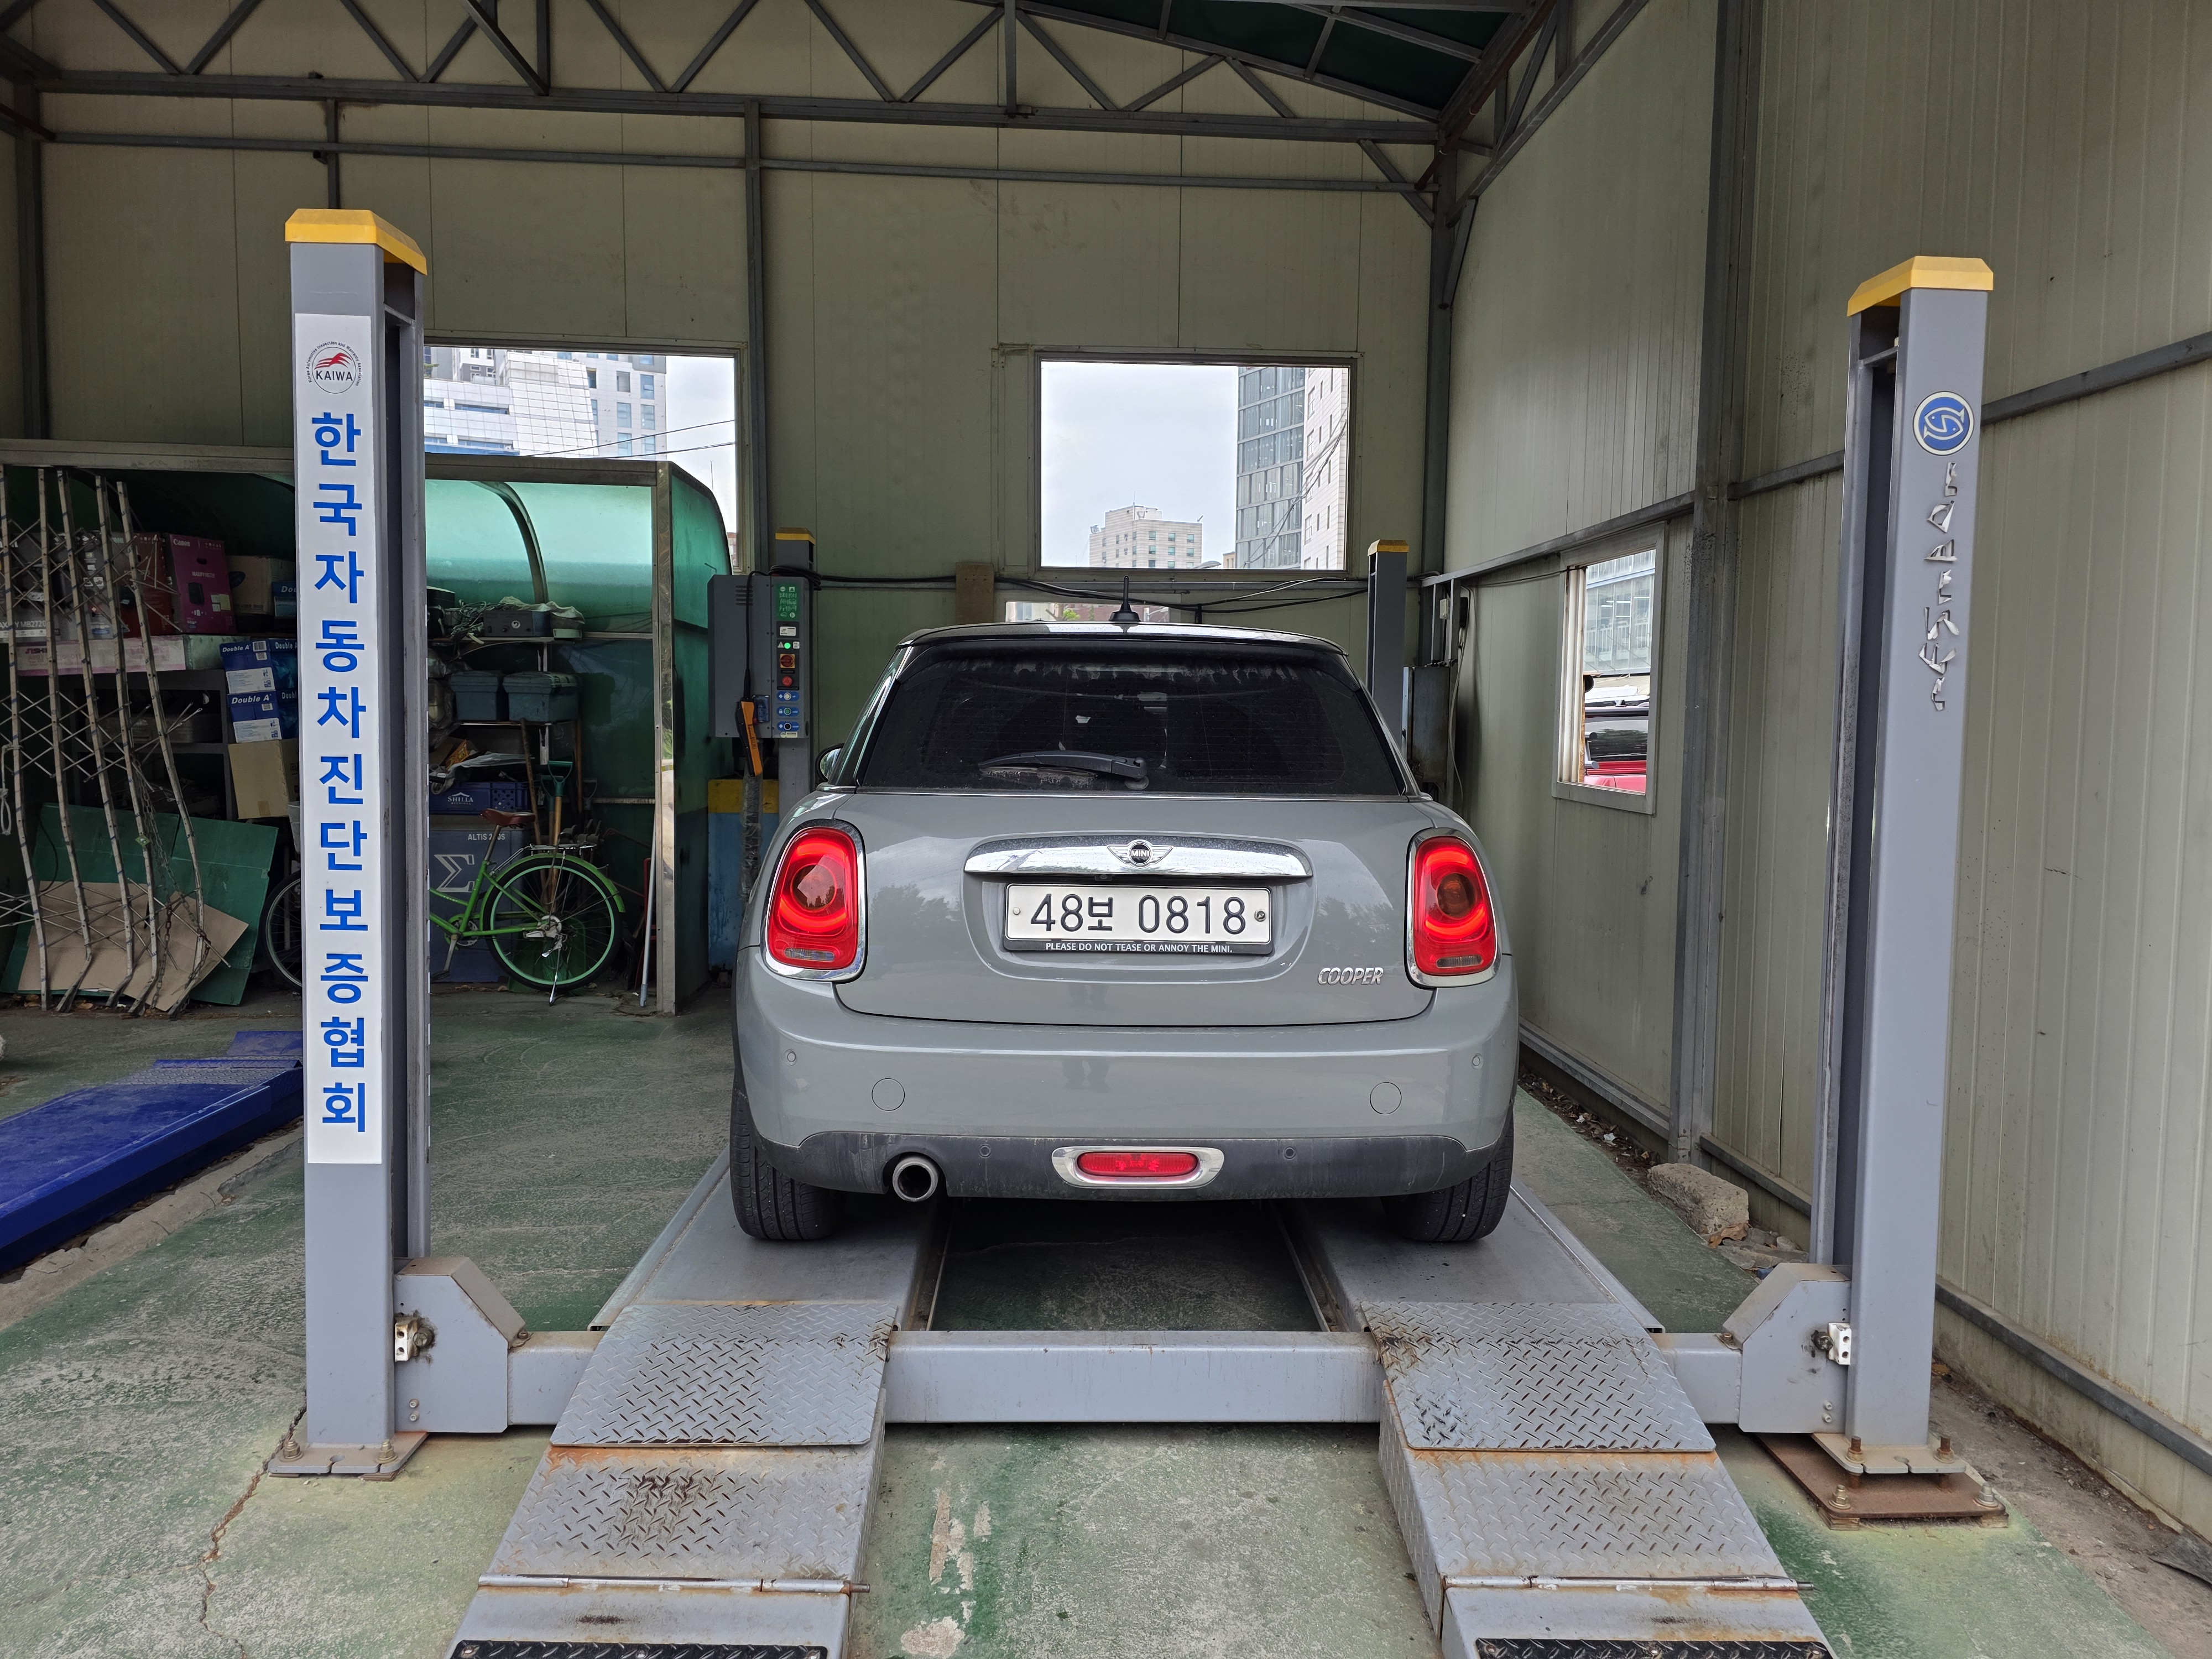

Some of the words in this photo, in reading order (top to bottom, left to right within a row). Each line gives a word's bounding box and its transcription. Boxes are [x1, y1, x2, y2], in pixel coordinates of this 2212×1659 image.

[317, 341, 337, 349] Inspection
[346, 345, 359, 361] Warranty
[316, 370, 353, 381] KAIWA
[173, 539, 191, 547] Canon
[231, 695, 261, 705] Double
[1030, 893, 1113, 932] 48보
[1138, 895, 1246, 935] 0818
[1046, 942, 1077, 951] PLEASE
[1078, 943, 1092, 951] DO
[1094, 943, 1113, 951] NOT
[1115, 943, 1142, 952] TEASE
[1158, 944, 1190, 952] ANNOY
[1318, 967, 1384, 985] COOPER
